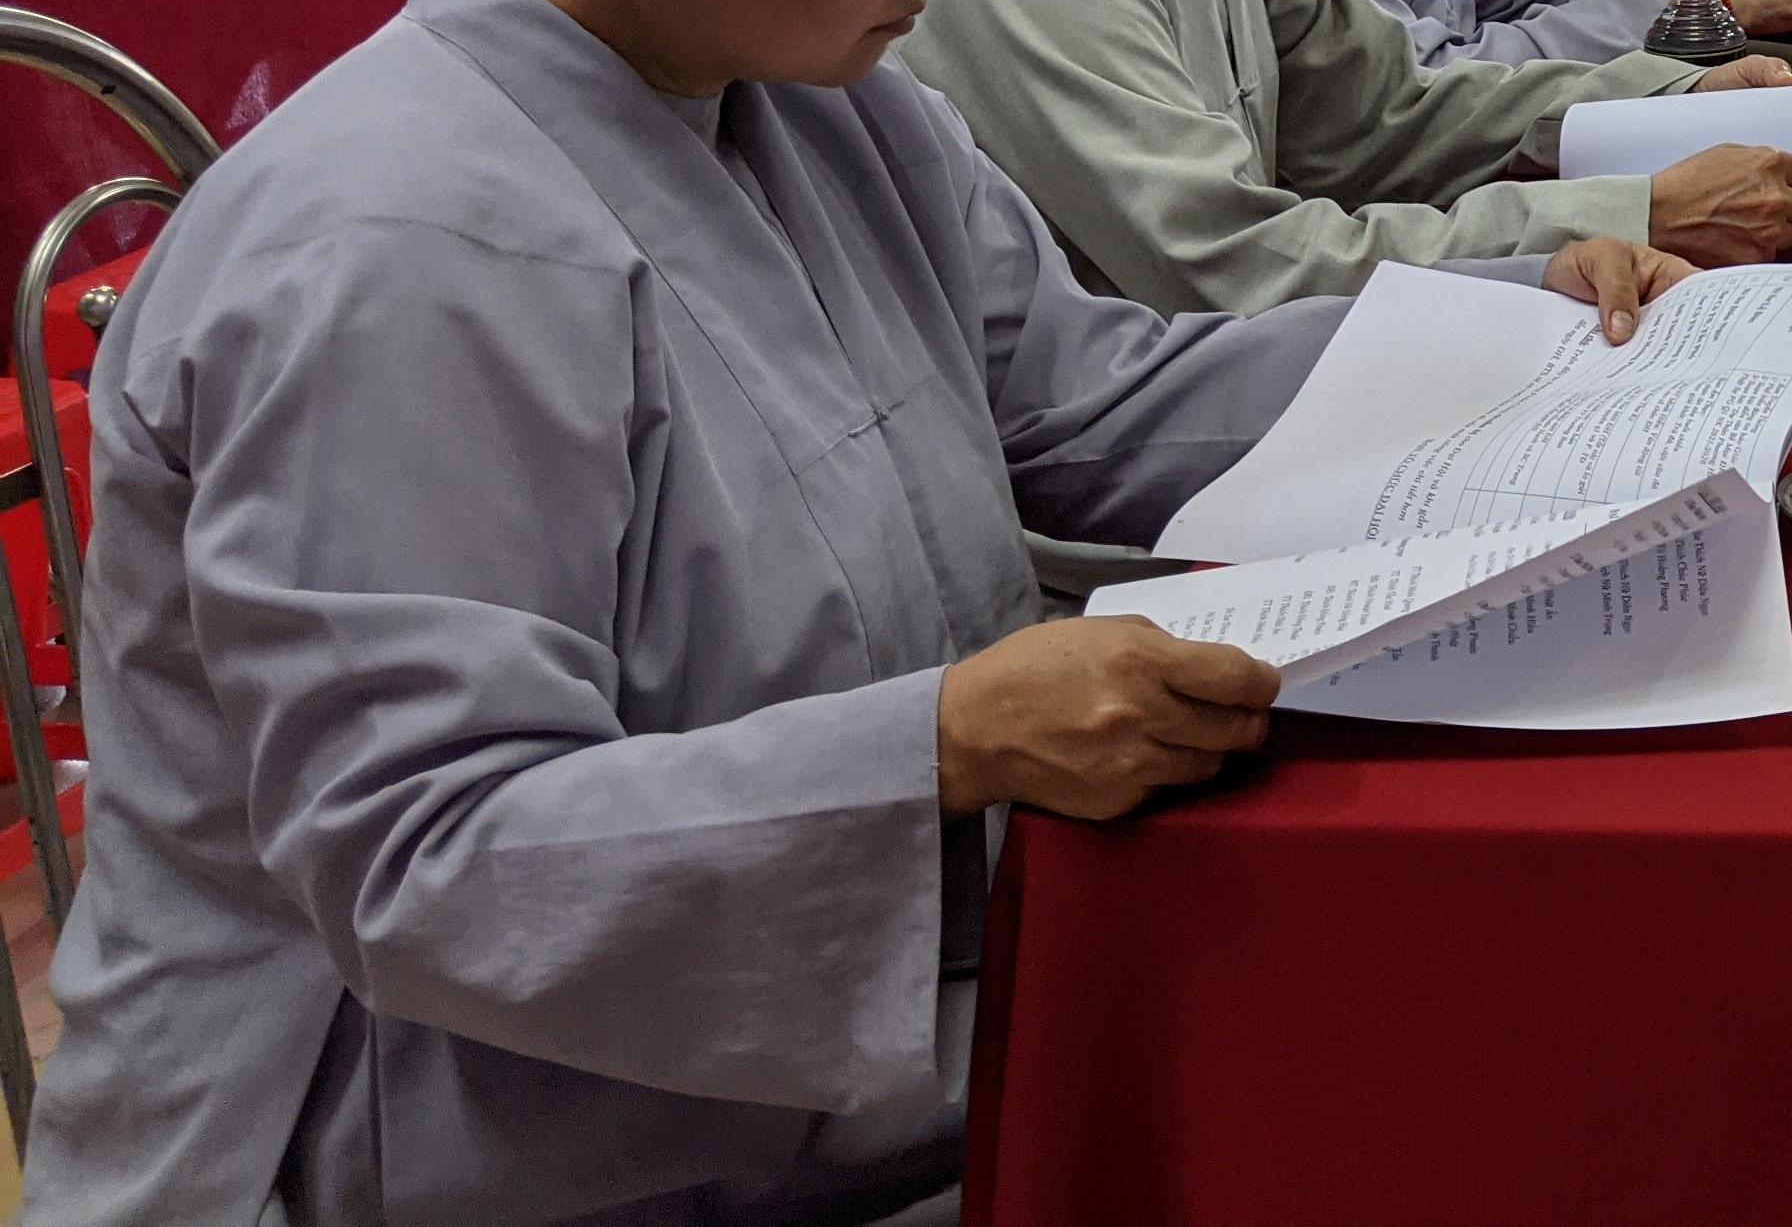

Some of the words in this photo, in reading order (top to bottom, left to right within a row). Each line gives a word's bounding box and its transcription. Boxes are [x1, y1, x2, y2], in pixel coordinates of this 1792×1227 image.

[1414, 469, 1425, 483] chi
[1436, 461, 1451, 477] Hội
[1383, 464, 1407, 492] CHỨC
[1430, 479, 1439, 490] và
[1406, 484, 1418, 500] tiết
[1423, 492, 1436, 507] khi
[1398, 501, 1412, 521] hơn
[1416, 508, 1429, 528] gần
[1694, 542, 1705, 563] Thích
[1697, 564, 1706, 577] Nữ
[1620, 581, 1631, 593] Nữ
[1659, 582, 1669, 611] Phương
